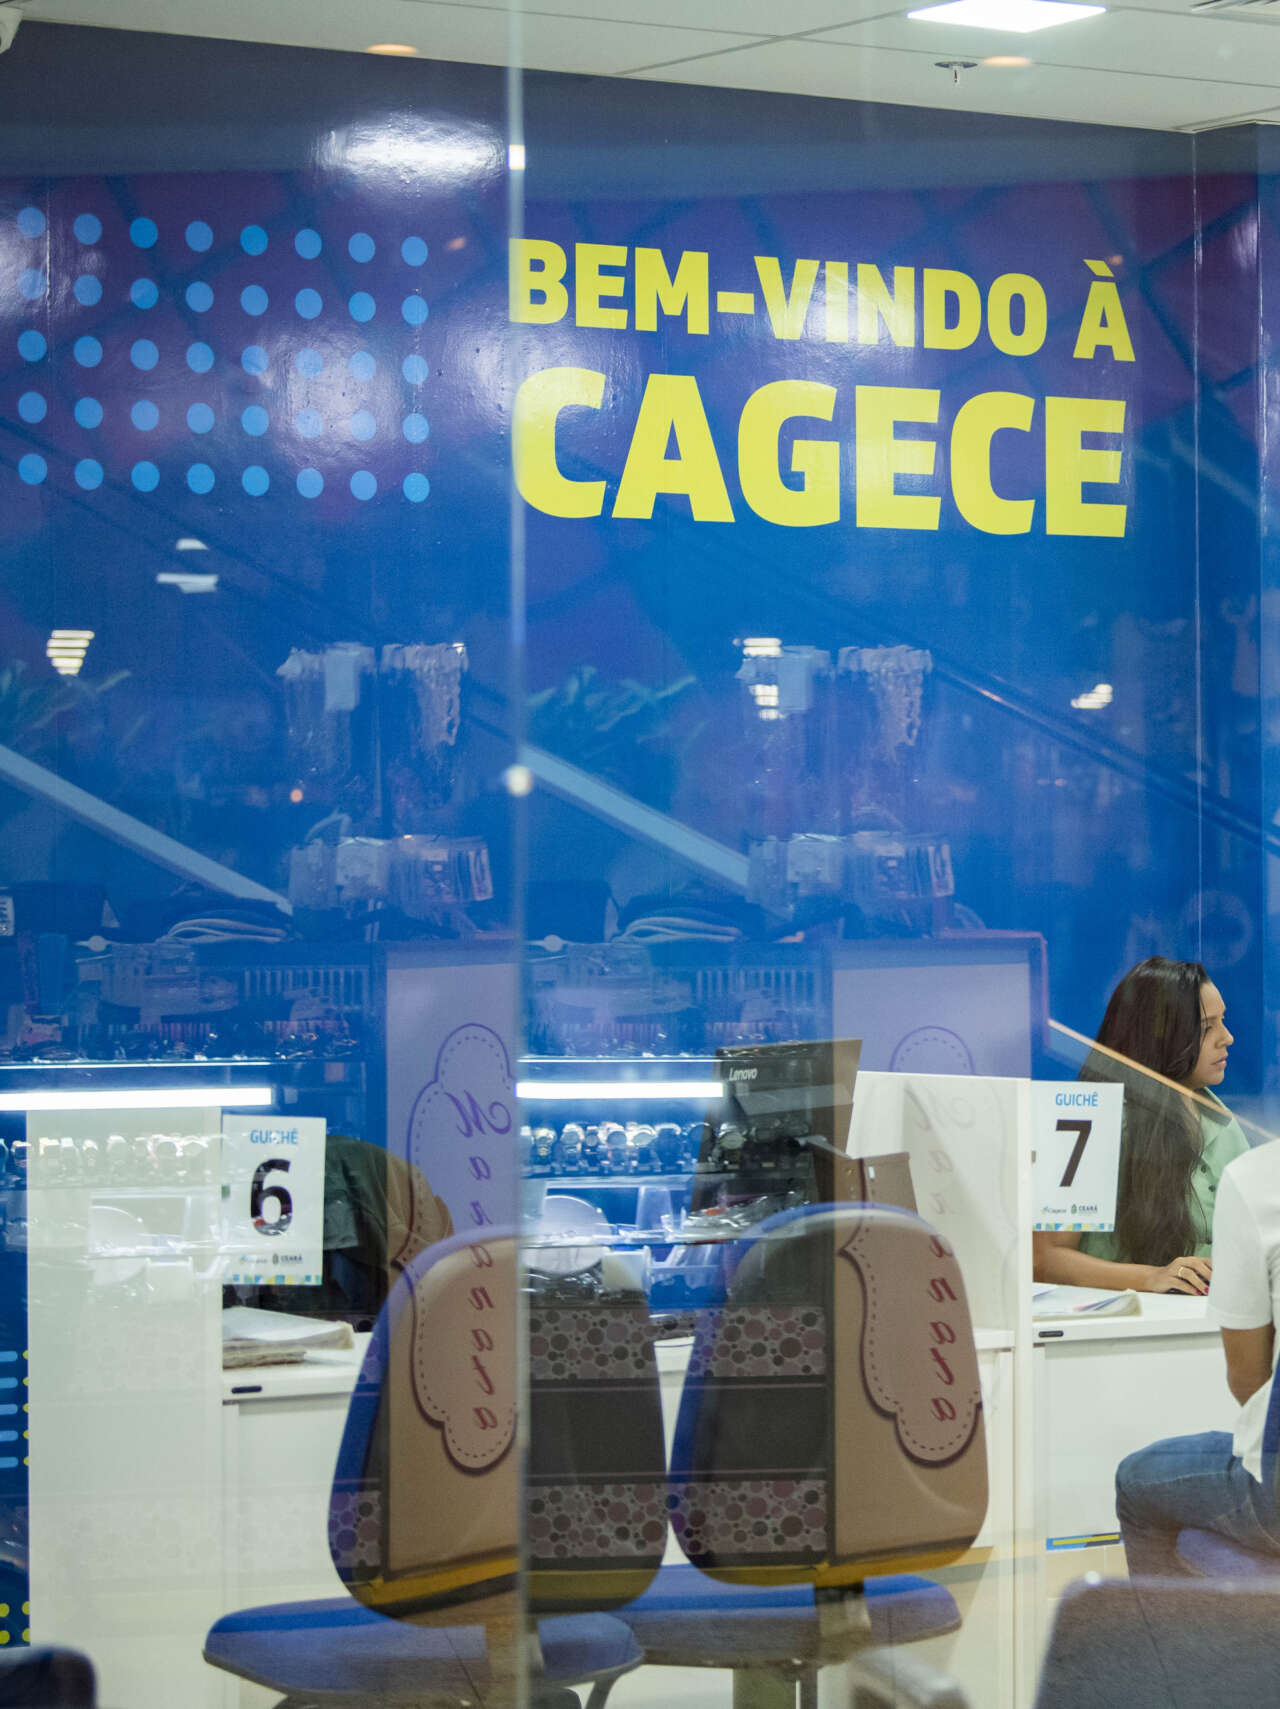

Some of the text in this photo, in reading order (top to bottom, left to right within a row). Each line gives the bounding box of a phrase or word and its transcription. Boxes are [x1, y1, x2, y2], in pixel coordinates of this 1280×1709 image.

[508, 238, 1136, 362] BEM-VINDO À
[513, 366, 1128, 538] CAGECE
[729, 1067, 758, 1081] Lenovo
[1055, 1091, 1099, 1107] GUICHÊ
[1055, 1118, 1093, 1188] 7
[250, 1158, 293, 1237] 6
